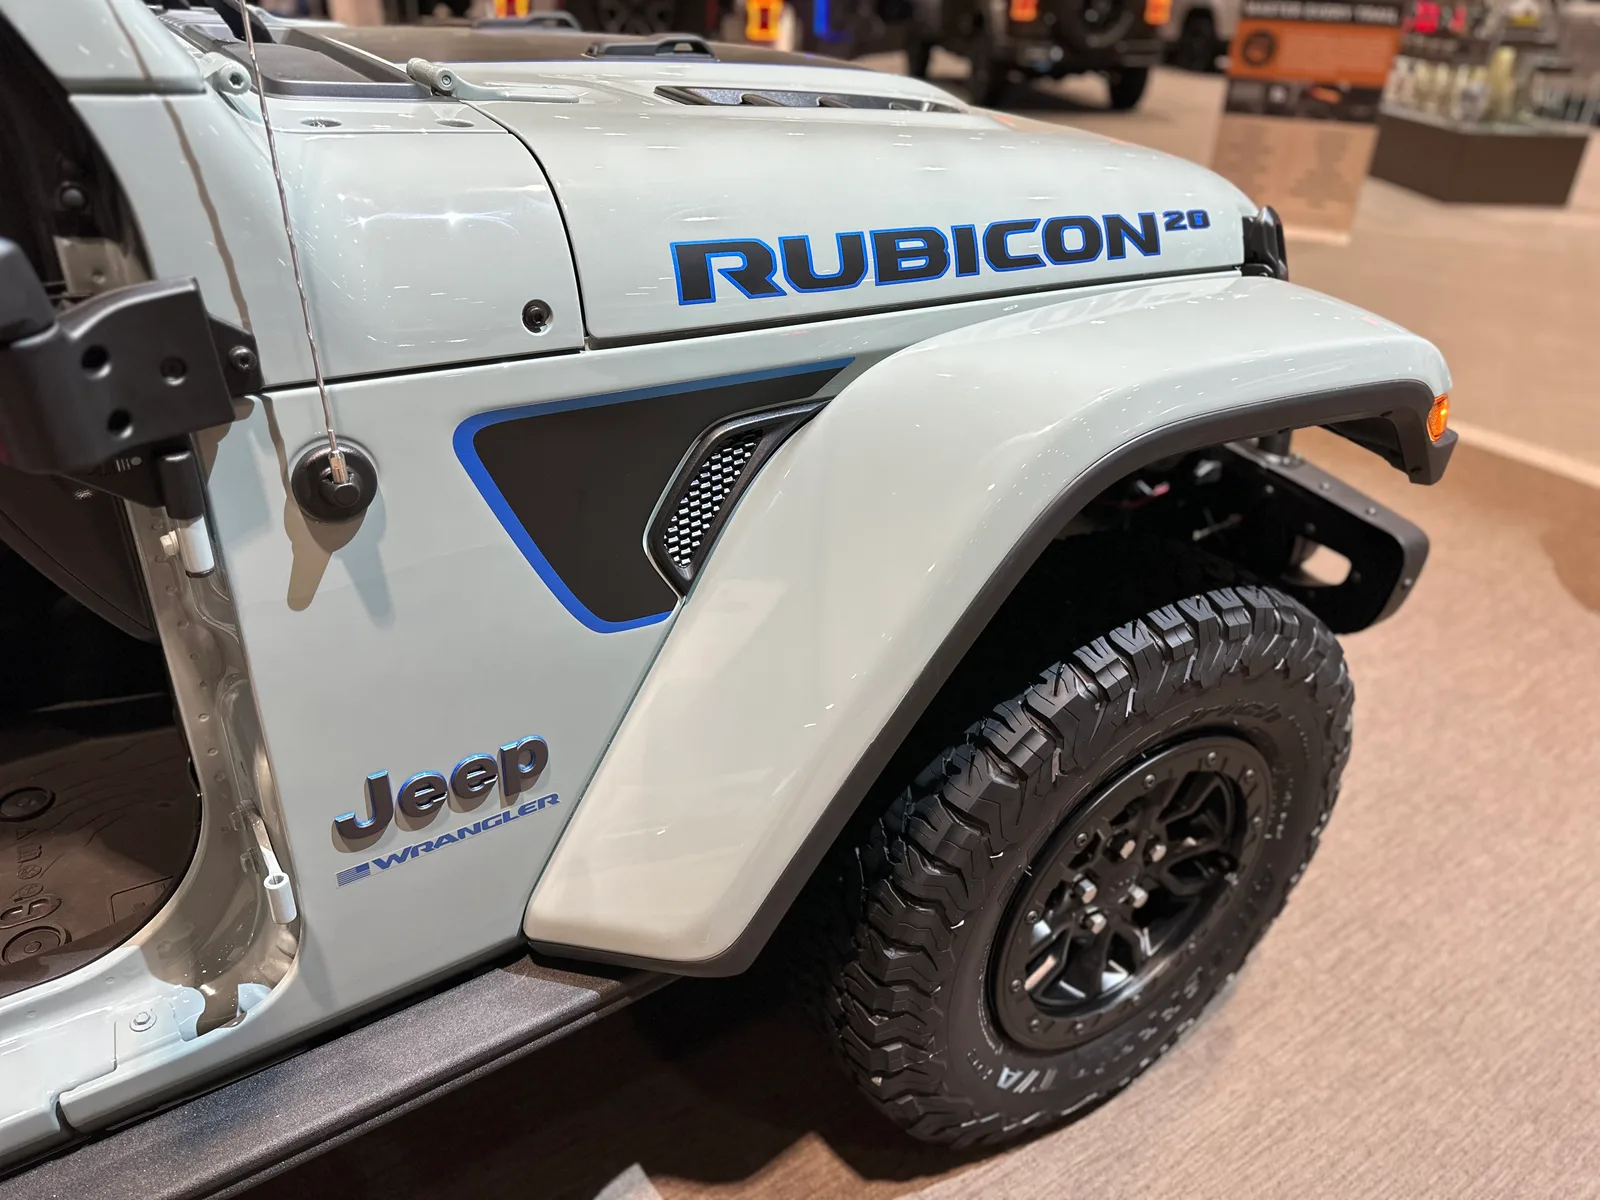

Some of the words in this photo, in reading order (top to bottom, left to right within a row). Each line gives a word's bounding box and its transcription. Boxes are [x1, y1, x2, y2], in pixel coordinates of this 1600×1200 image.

[670, 211, 1161, 306] RUBICON
[333, 734, 549, 840] Jeep
[371, 792, 561, 870] WRANGLER
